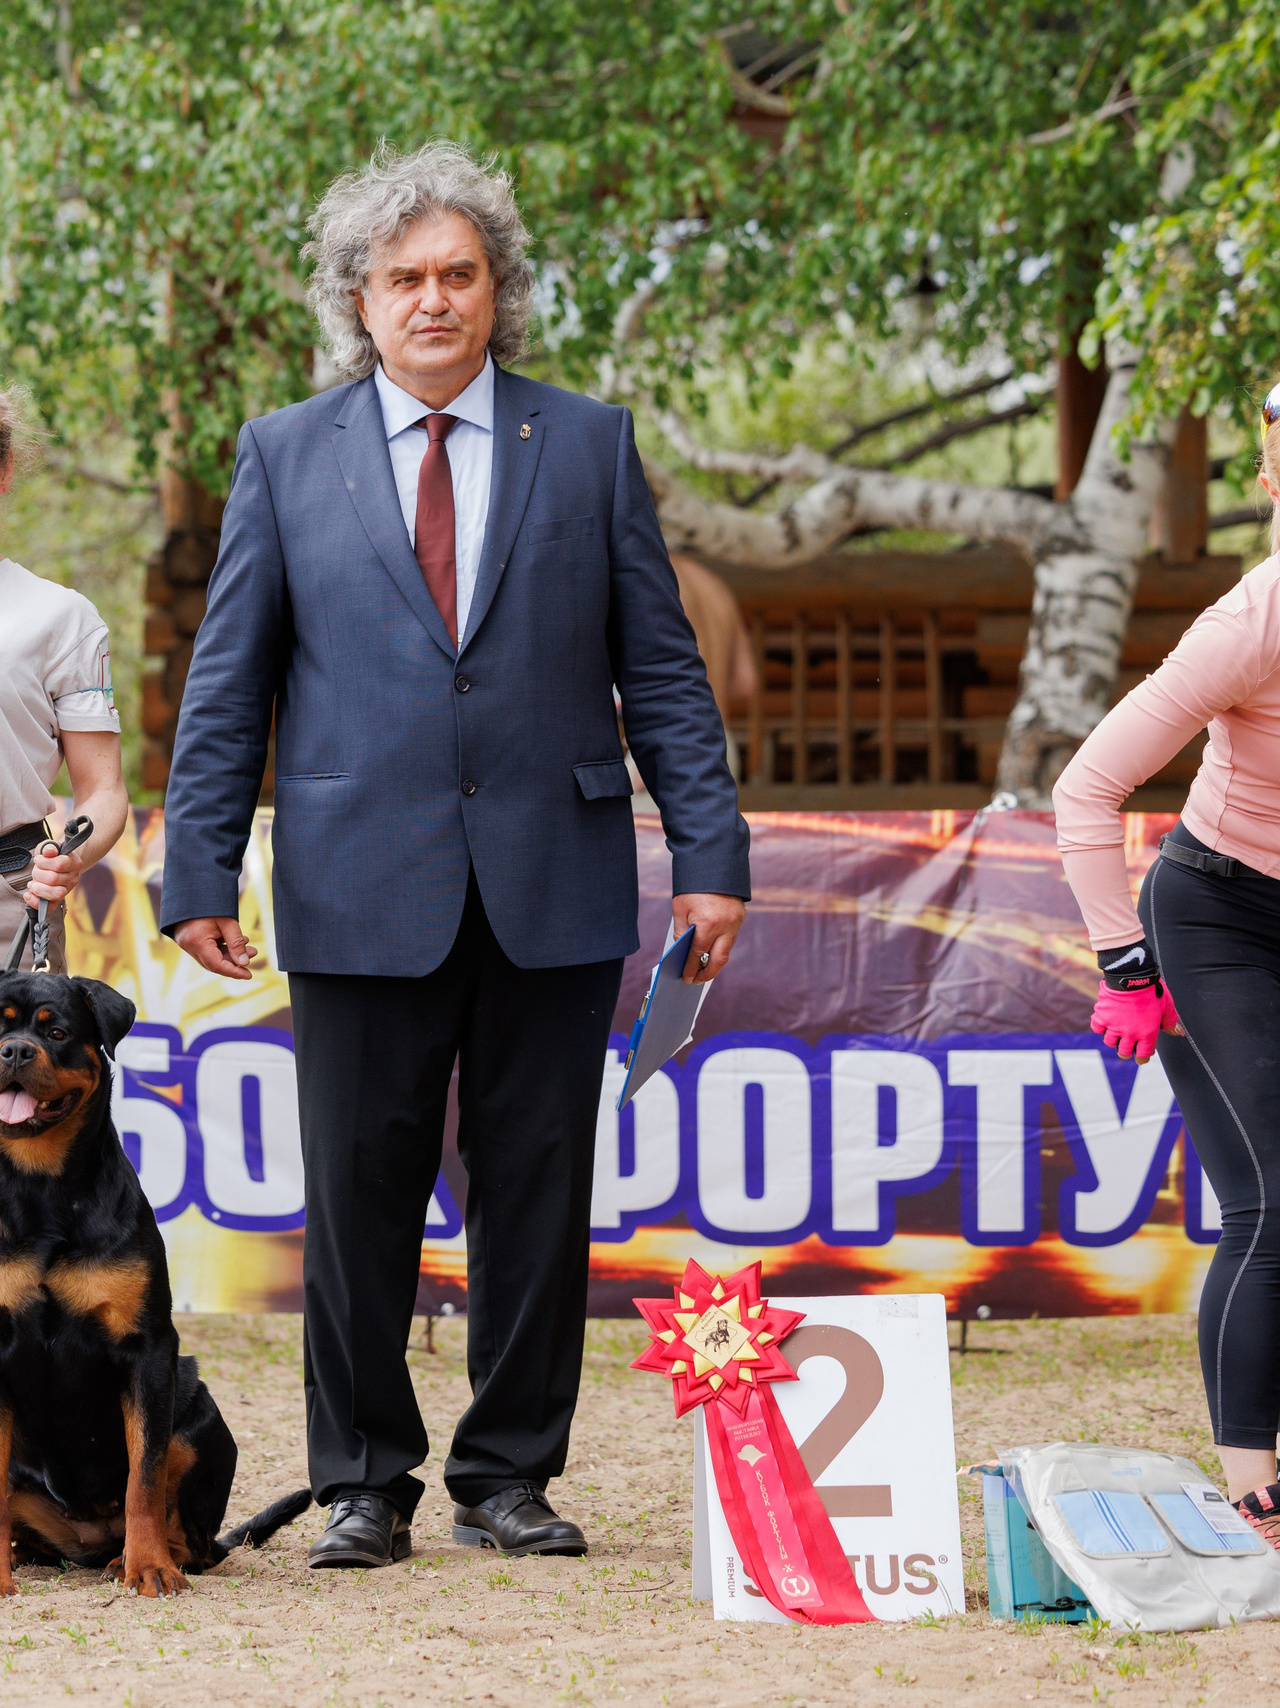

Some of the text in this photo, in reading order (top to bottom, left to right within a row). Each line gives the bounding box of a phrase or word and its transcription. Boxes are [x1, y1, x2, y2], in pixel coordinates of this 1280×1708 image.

[590, 1046, 1222, 1233] ОРТУ
[779, 1324, 893, 1518] 2
[726, 1556, 736, 1598] PREMIUM
[755, 1469, 789, 1560] КУБОК ФОРТУНЫ
